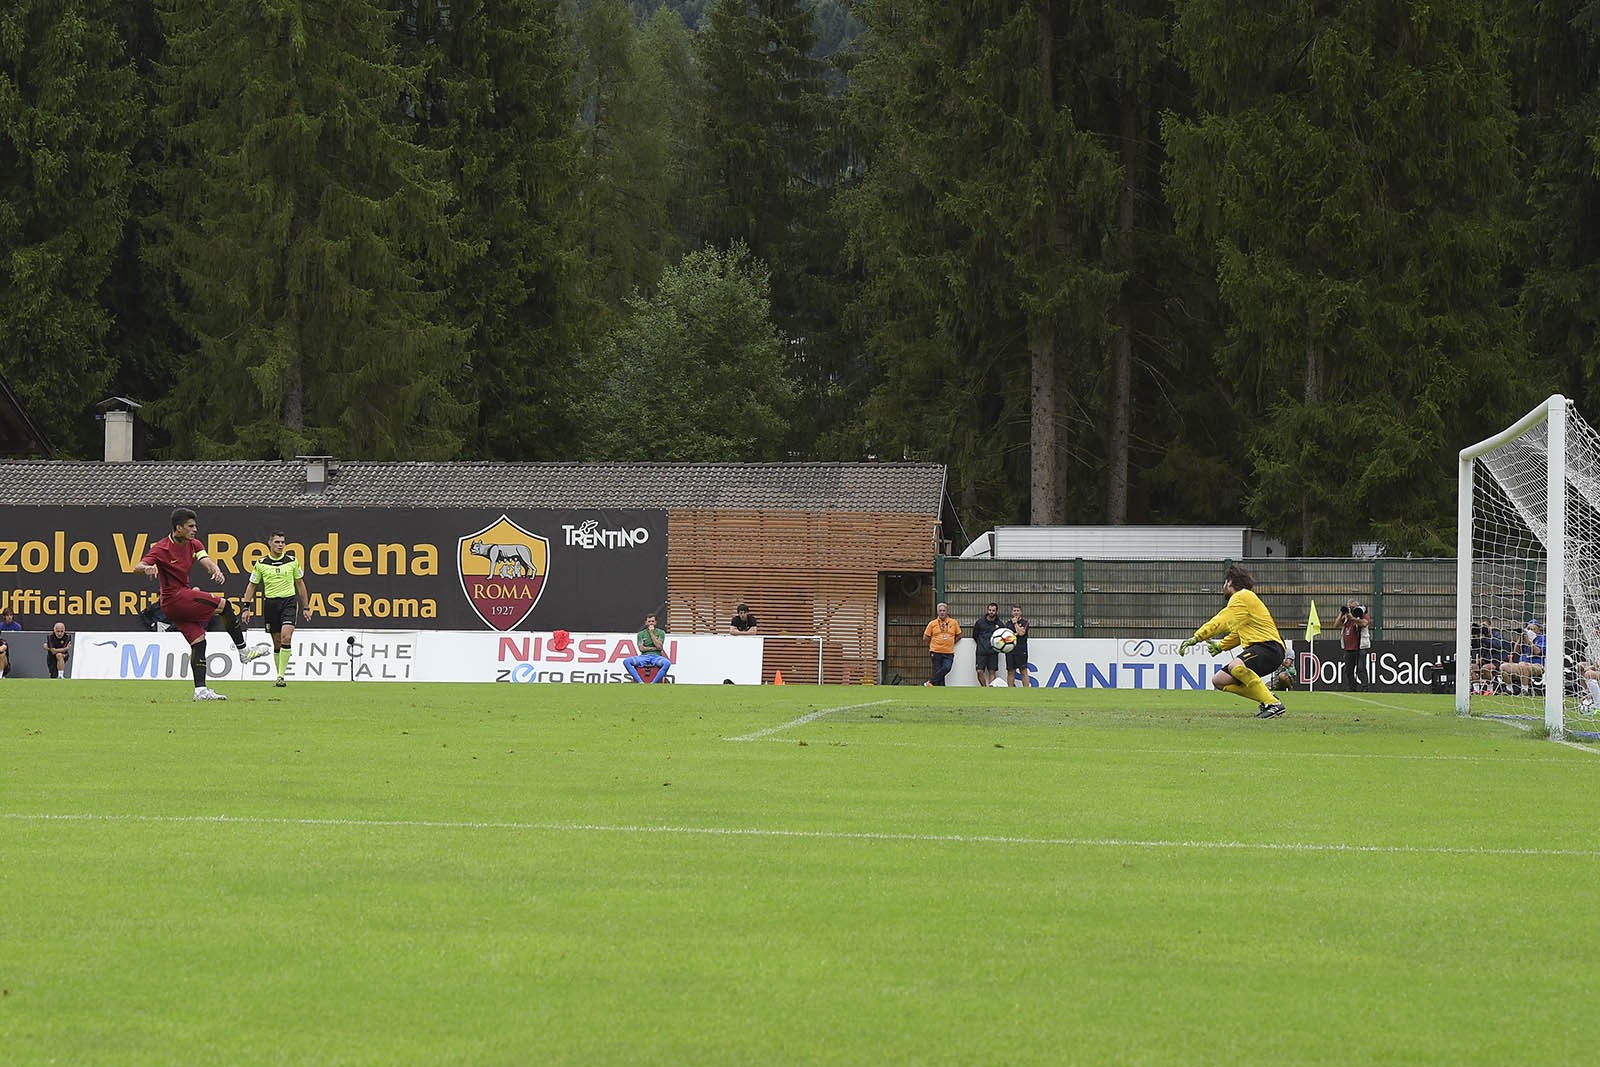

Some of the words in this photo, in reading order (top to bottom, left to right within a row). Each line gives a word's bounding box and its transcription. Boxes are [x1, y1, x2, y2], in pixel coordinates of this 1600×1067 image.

[474, 584, 533, 600] ROMA
[308, 593, 346, 618] AS
[353, 593, 437, 618] Roma
[491, 606, 515, 616] 1927
[256, 642, 412, 659] INICHE
[1158, 643, 1209, 655] GRPP
[570, 669, 676, 684] Emissn
